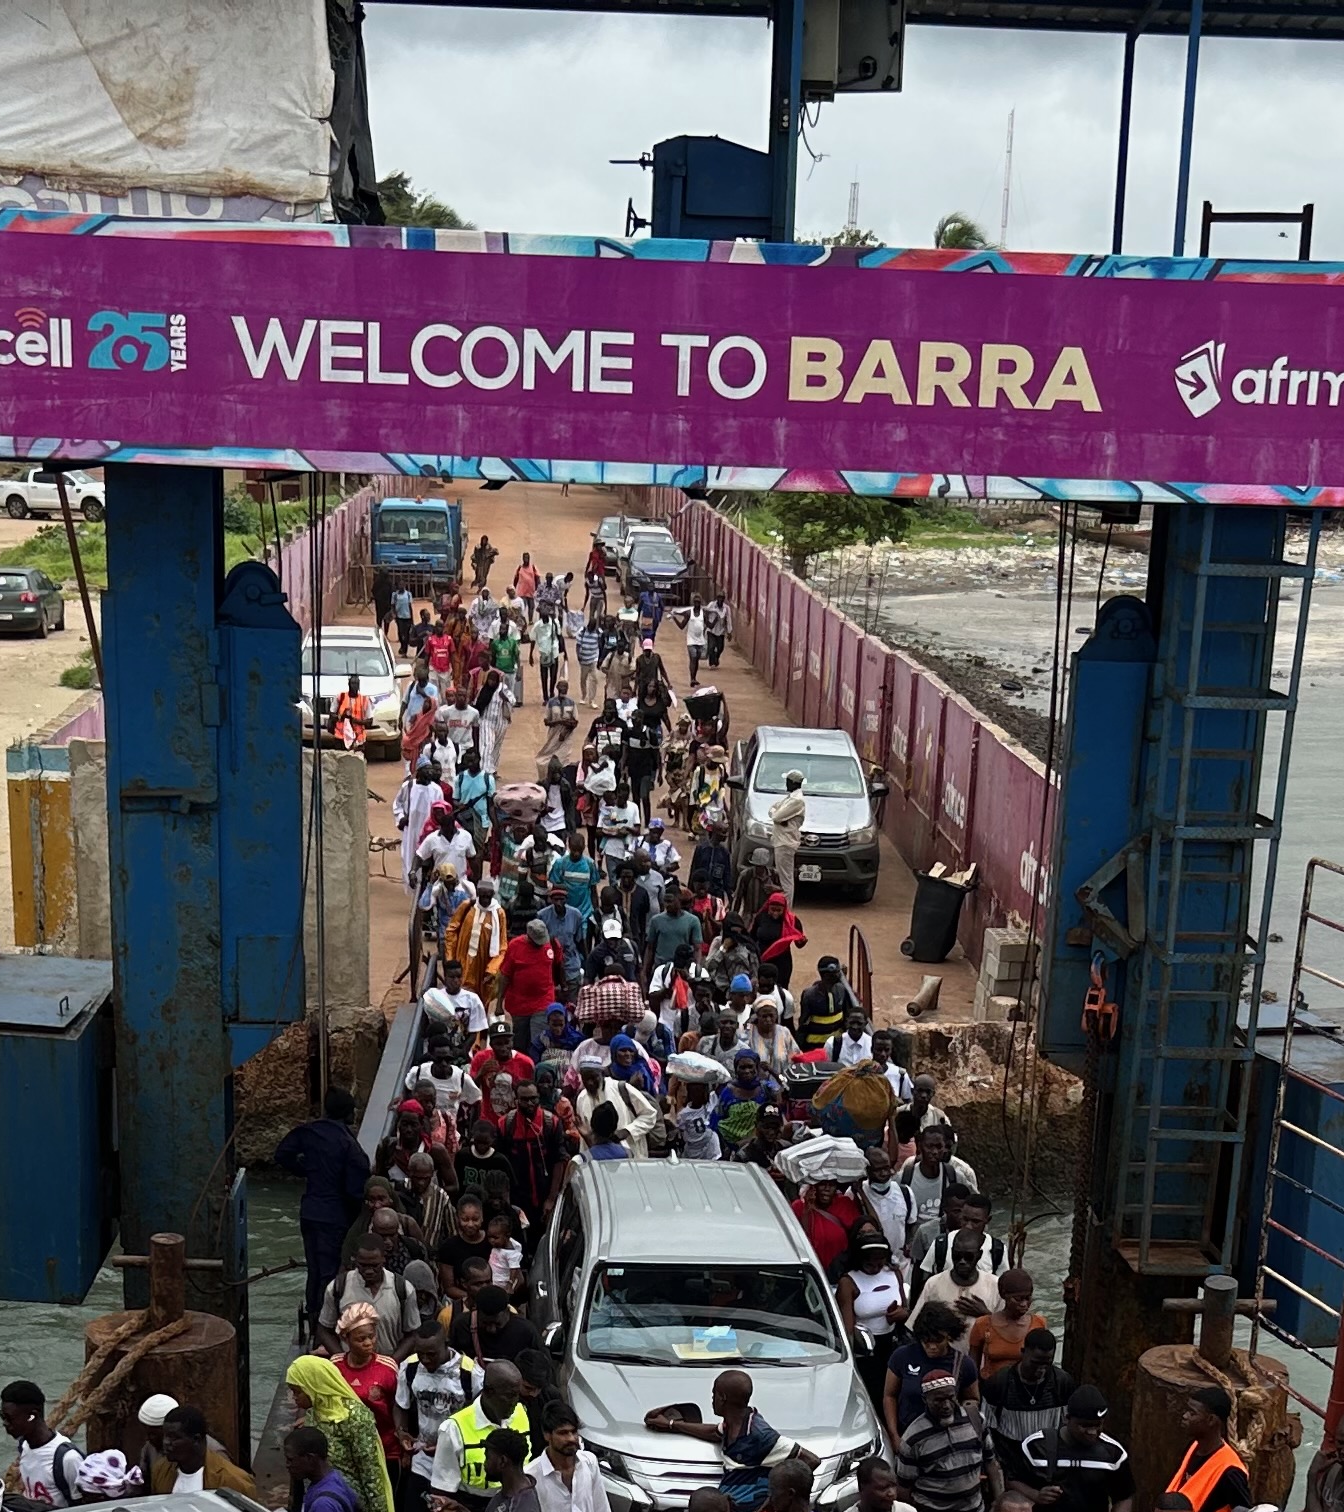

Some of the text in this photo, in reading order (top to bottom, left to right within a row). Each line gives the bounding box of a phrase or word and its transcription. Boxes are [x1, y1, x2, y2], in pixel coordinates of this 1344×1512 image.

[87, 310, 169, 372] 25
[169, 313, 188, 373] YEARS
[230, 315, 1104, 414] WELCOME TO BARRA
